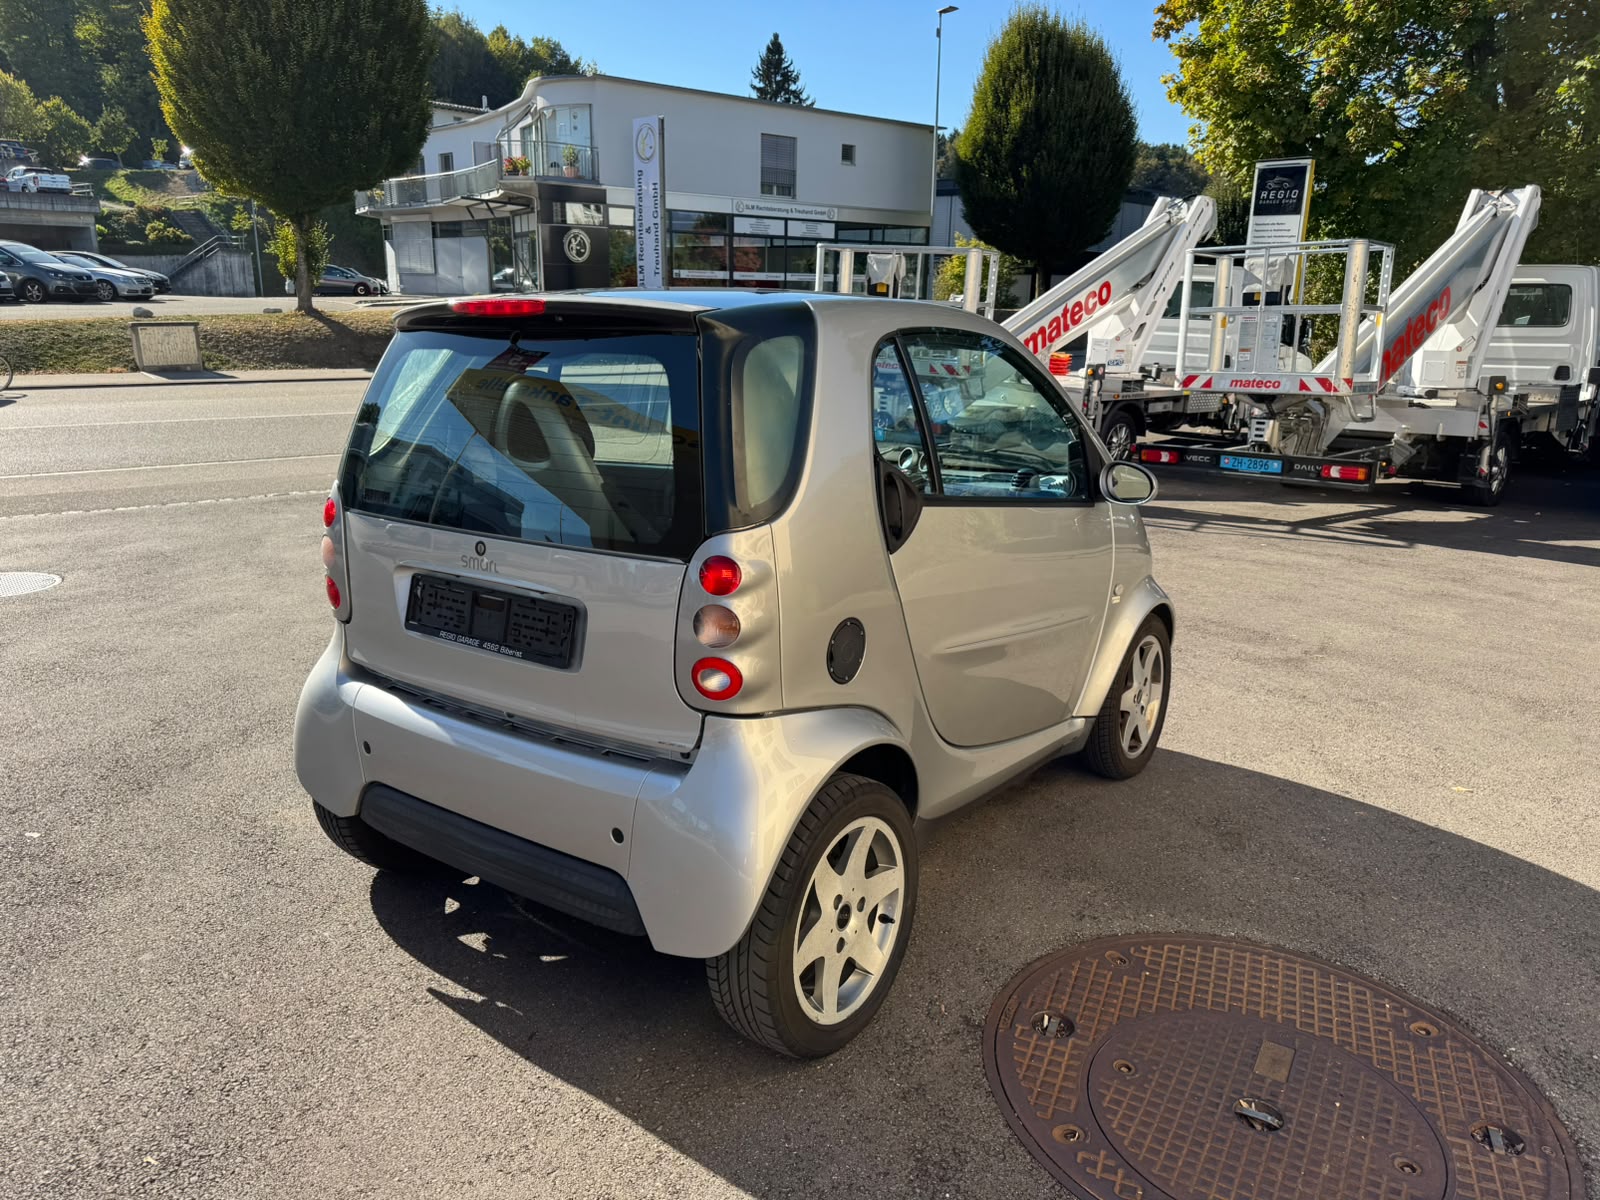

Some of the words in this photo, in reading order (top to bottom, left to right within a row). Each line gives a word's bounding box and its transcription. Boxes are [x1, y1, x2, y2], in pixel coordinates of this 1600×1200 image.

[1260, 189, 1299, 199] REGIO
[637, 169, 645, 260] Rechtsberatung
[645, 226, 652, 235] &
[653, 222, 661, 277] Treuhand
[1023, 280, 1112, 355] mateco
[1229, 378, 1281, 390] mateco
[1294, 463, 1322, 471] DAILY
[460, 554, 500, 574] smart
[456, 635, 480, 647] GARAGE
[482, 642, 500, 652] 4562
[499, 645, 523, 658] Biberist
